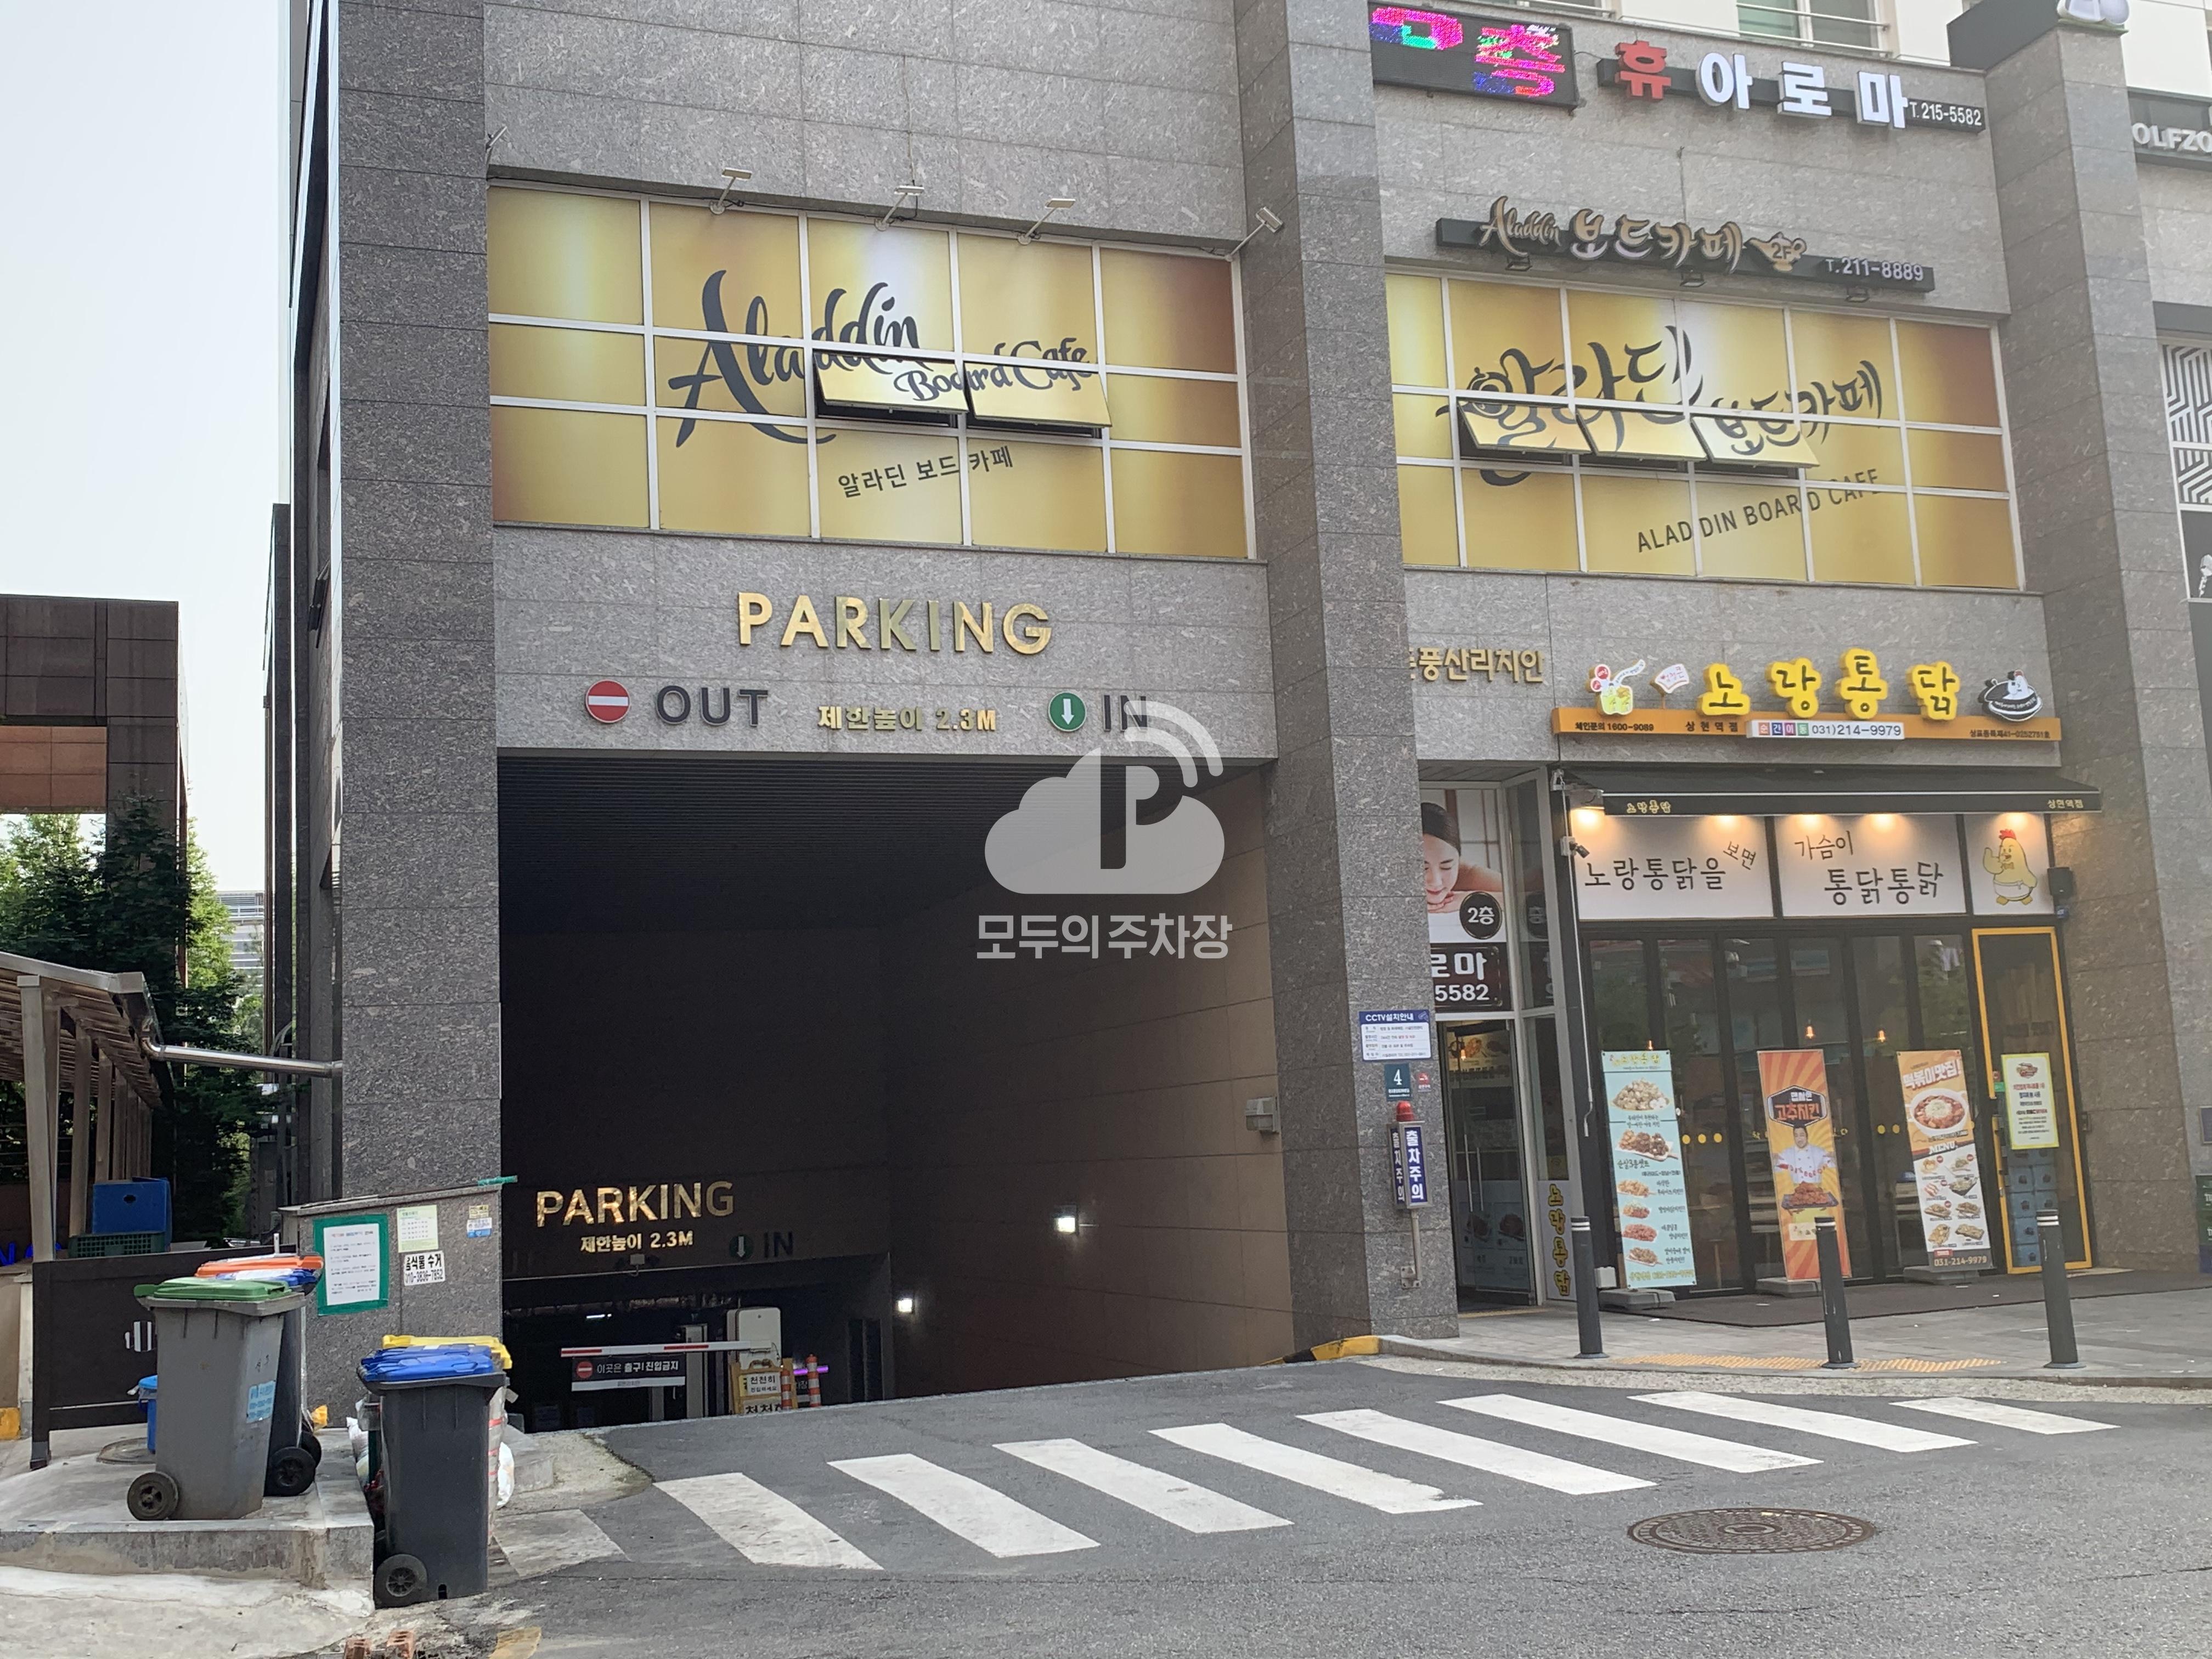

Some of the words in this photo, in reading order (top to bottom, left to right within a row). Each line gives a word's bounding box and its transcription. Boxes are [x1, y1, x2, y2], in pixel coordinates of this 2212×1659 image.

[1480, 196, 1560, 256] Aladdin
[1570, 208, 1746, 273] 보드카페
[1771, 242, 1791, 259] 2F
[668, 270, 923, 448] Aladdin
[894, 342, 1012, 402] Board
[1012, 337, 1093, 392] Cafe
[838, 467, 907, 499] 알라딘
[917, 455, 960, 481] 보드
[969, 445, 1014, 472] 카페
[1637, 510, 1738, 553] ALADDIN
[1745, 492, 1821, 527] BOARD
[1829, 468, 1881, 506] CAFE
[738, 591, 1052, 655] PARKING
[1409, 647, 1545, 682] 풍산리치안
[1703, 649, 1960, 719] 노랑통닭
[656, 685, 769, 727] OUT
[817, 705, 923, 731] 제한높이
[935, 708, 997, 731] 2.3M
[1103, 695, 1148, 732] IN
[1812, 724, 1902, 736] 031)214-9979
[1627, 800, 1671, 814] 노랑통닭
[1794, 830, 1854, 861] 가슴이
[1584, 857, 1726, 891] 노랑통닭을
[1722, 841, 1757, 871] 보면
[1824, 861, 1944, 906] 통닭통닭
[1467, 906, 1496, 926] 2층
[1435, 984, 1490, 1002] 5582
[1365, 1013, 1414, 1022] CCTV설치안내
[1393, 1069, 1402, 1085] 4
[1392, 1132, 1405, 1201] 출차주의
[1406, 1130, 1424, 1200] 출차주의
[536, 1180, 735, 1227] PARKING
[580, 1232, 642, 1254] 제한높이
[651, 1230, 693, 1249] 2.3M
[763, 1231, 794, 1259] IN
[1548, 1183, 1571, 1296] 노랑통닭
[427, 1253, 442, 1268] 수거
[1934, 1256, 1987, 1267] 031-214-9979
[597, 1363, 622, 1374] 이곳은
[645, 1361, 679, 1372] 진입금지
[750, 1375, 776, 1385] 천천히
